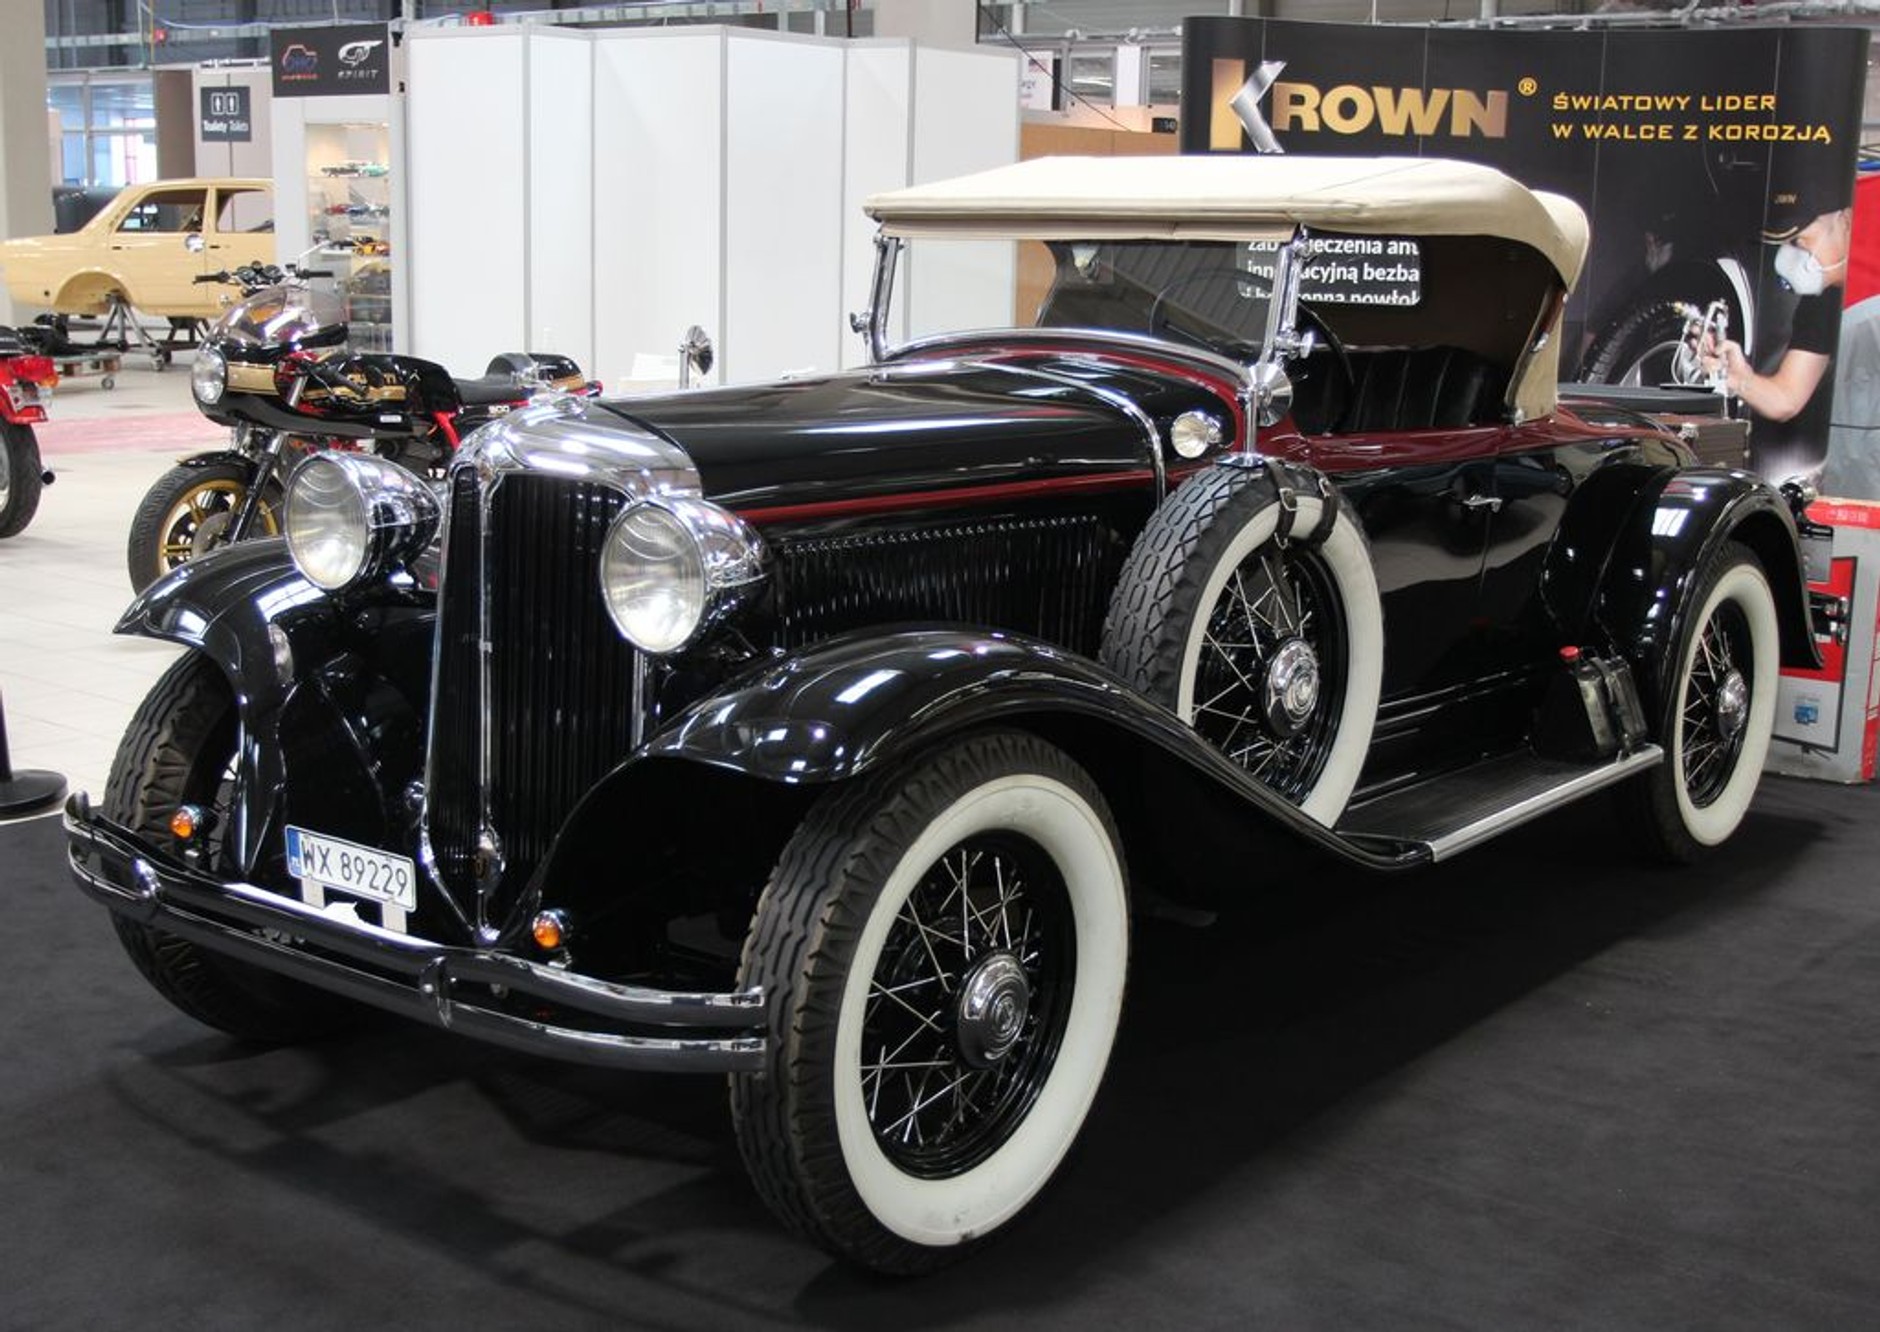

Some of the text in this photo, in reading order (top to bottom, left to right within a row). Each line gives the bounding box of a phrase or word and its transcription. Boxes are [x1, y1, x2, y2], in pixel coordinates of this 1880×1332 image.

[1210, 58, 1508, 154] KROWN
[1552, 91, 1776, 111] ŚWIATOWY LIDER
[1552, 124, 1832, 145] W WALCE Z KOROZJĄ
[301, 839, 408, 897] WX 89229
